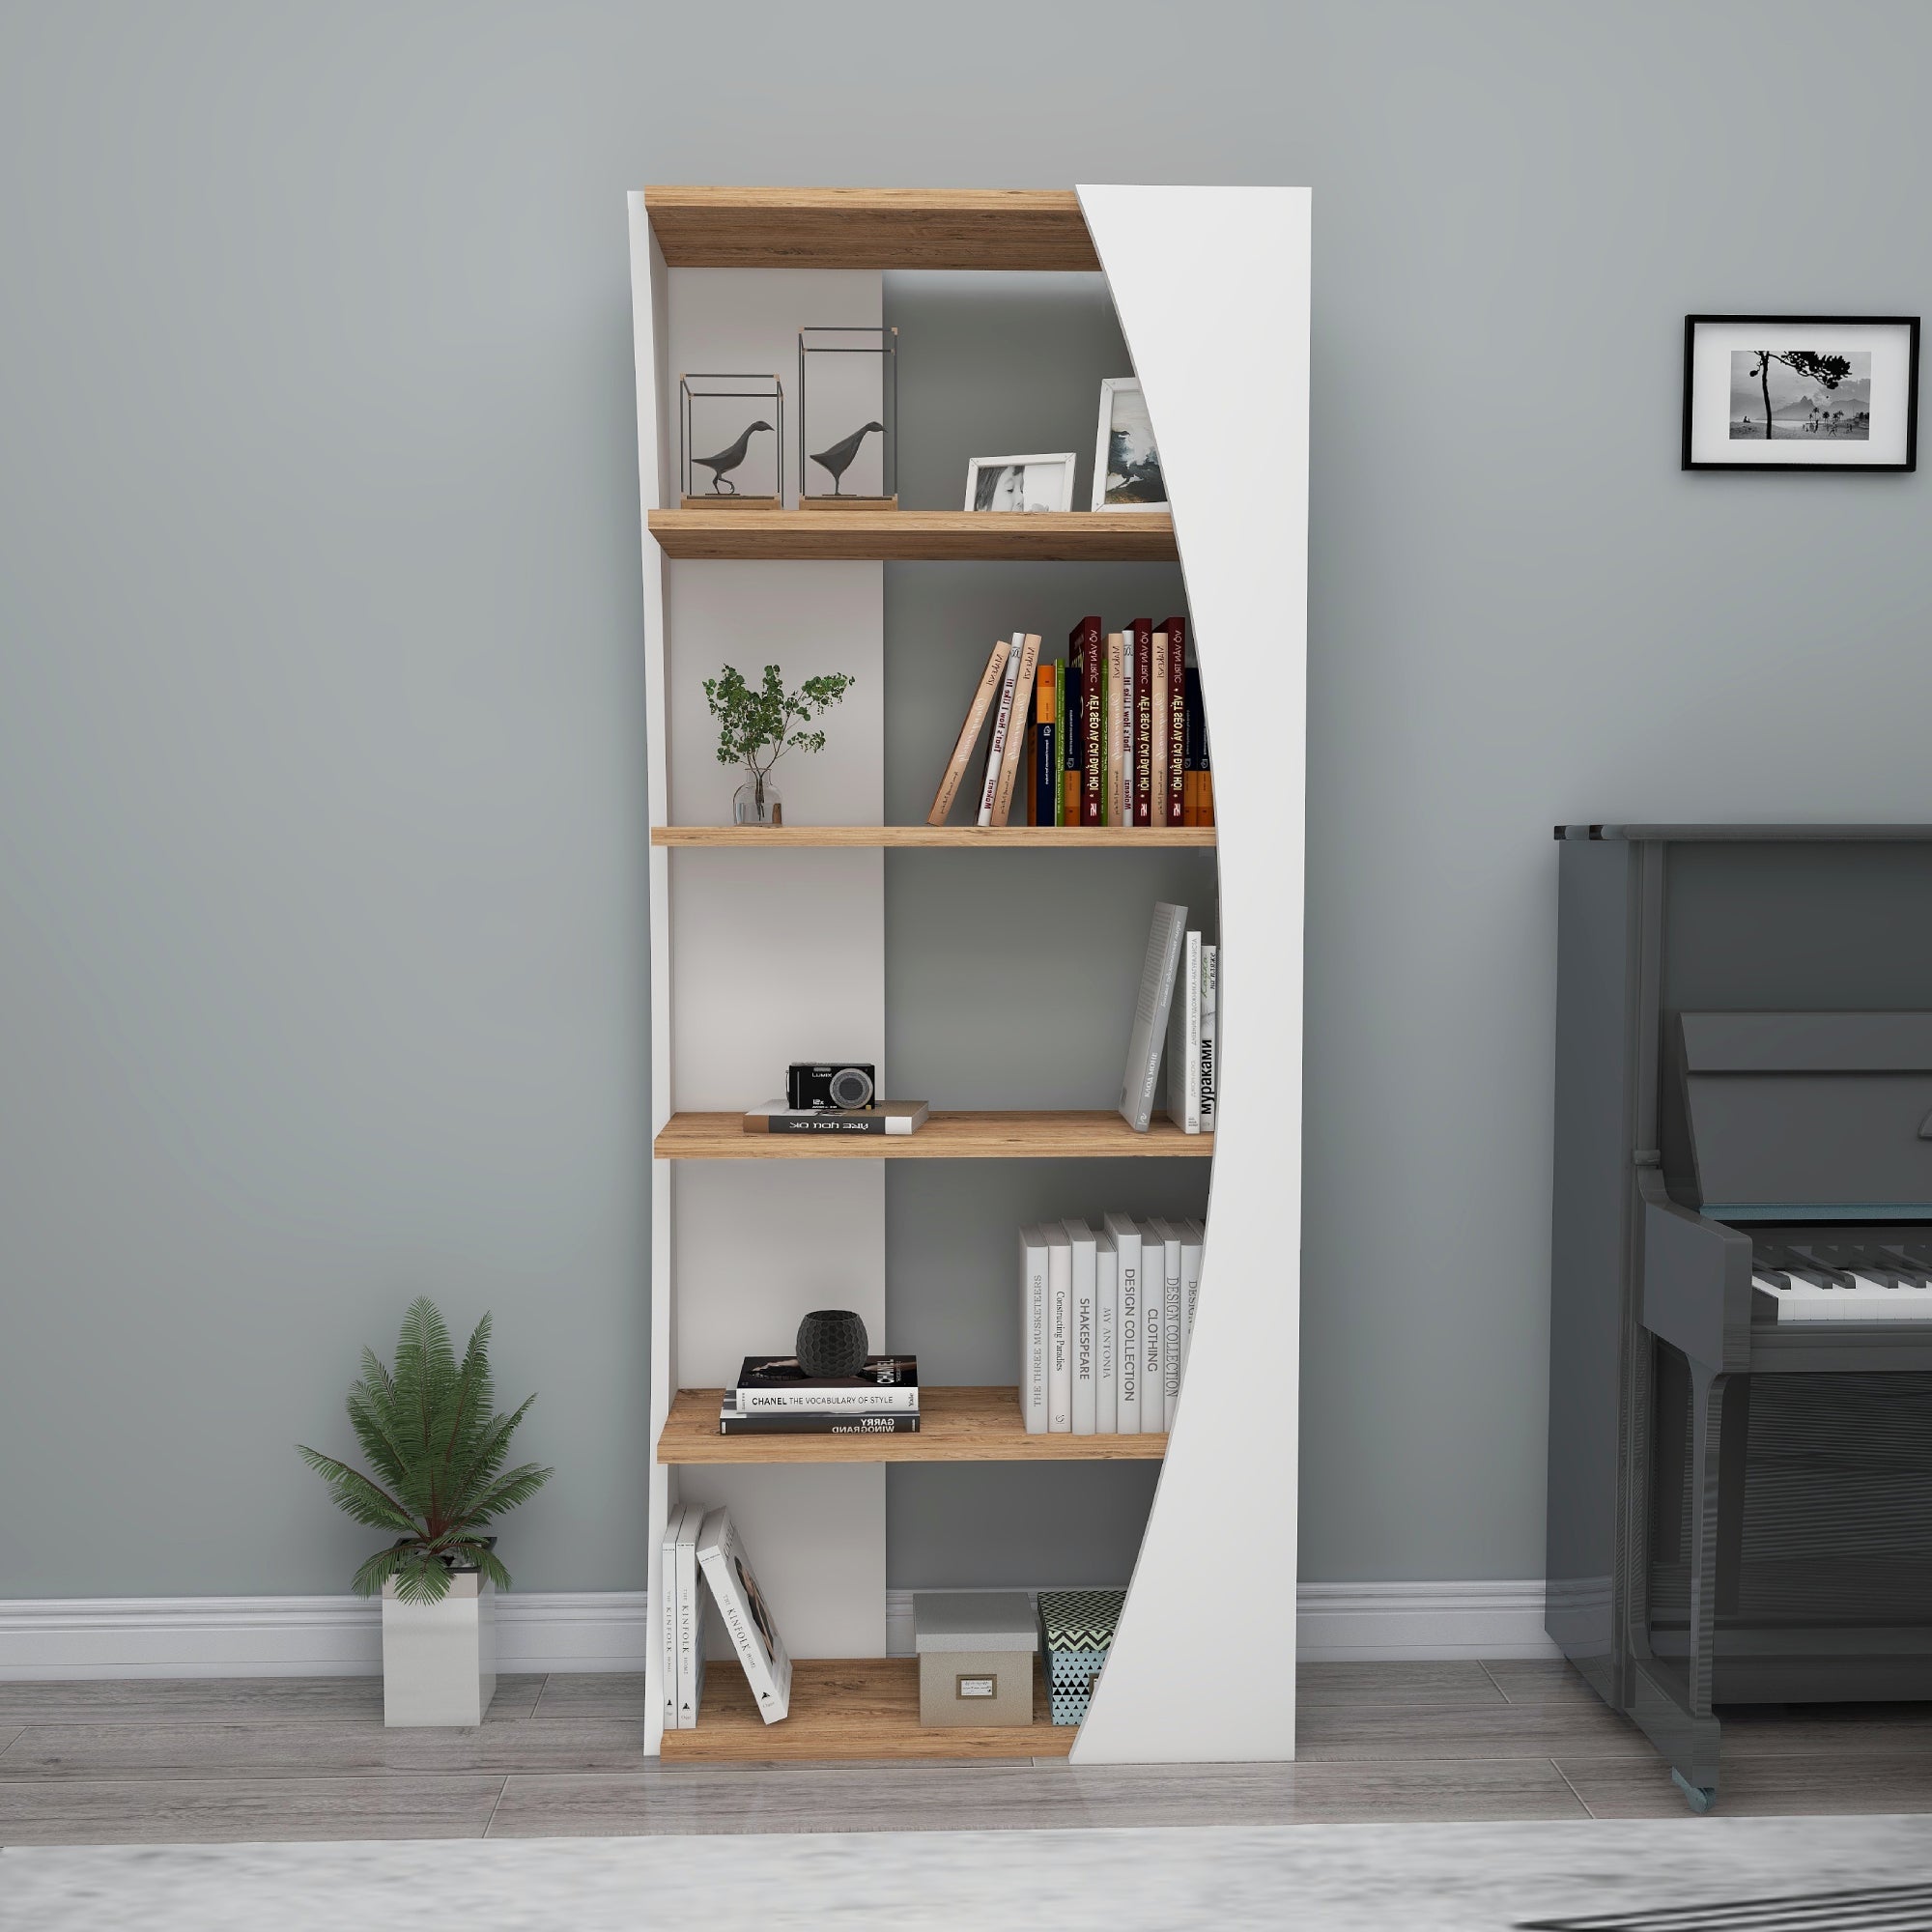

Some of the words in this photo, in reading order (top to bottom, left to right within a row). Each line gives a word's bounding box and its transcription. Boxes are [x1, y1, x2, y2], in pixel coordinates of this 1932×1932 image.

[1201, 1039, 1215, 1115] мураками
[1033, 1274, 1042, 1346] MUSKETEERS
[1054, 1291, 1065, 1339] Constructing
[1103, 1307, 1112, 1326] MY
[1124, 1268, 1135, 1317] DESIGN
[1166, 1276, 1179, 1322] DESIGN
[1080, 1297, 1090, 1380] SHAKESPEARE
[1103, 1327, 1112, 1378] ANTONIA
[1124, 1321, 1135, 1402] COLLECTION
[1148, 1308, 1158, 1373] CLOTHING
[1166, 1324, 1179, 1398] COLLECTION
[876, 1359, 895, 1384] CHANEL
[1033, 1348, 1041, 1382] THREE
[752, 1397, 787, 1406] CHANEL
[806, 1396, 856, 1405] VOCABULARY
[858, 1396, 869, 1405] OF
[1033, 1385, 1042, 1407] THE
[726, 1607, 751, 1652] KINFOLK
